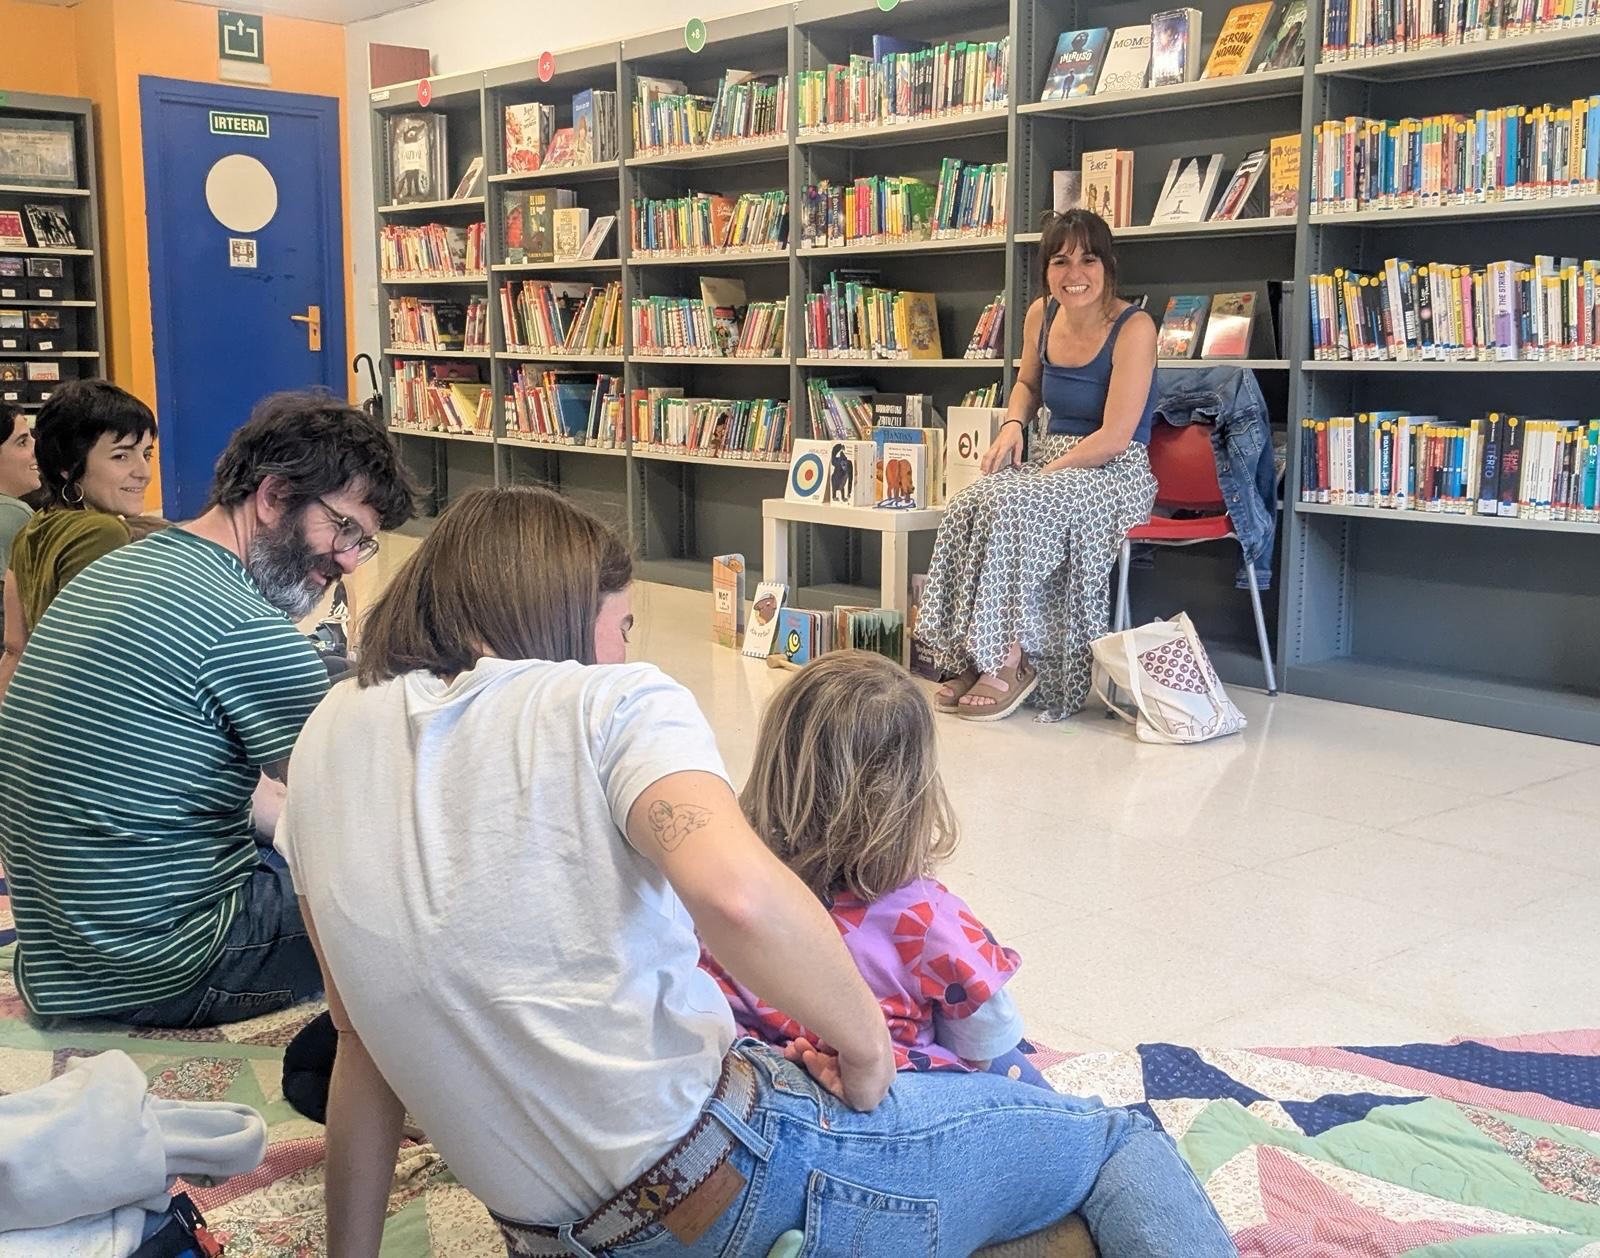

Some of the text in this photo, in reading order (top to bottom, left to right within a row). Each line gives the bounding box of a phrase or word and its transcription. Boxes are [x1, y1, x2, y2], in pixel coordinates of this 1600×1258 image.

[691, 28, 700, 39] +8
[214, 116, 265, 132] IRTEERA
[1498, 271, 1506, 293] STRIKE
